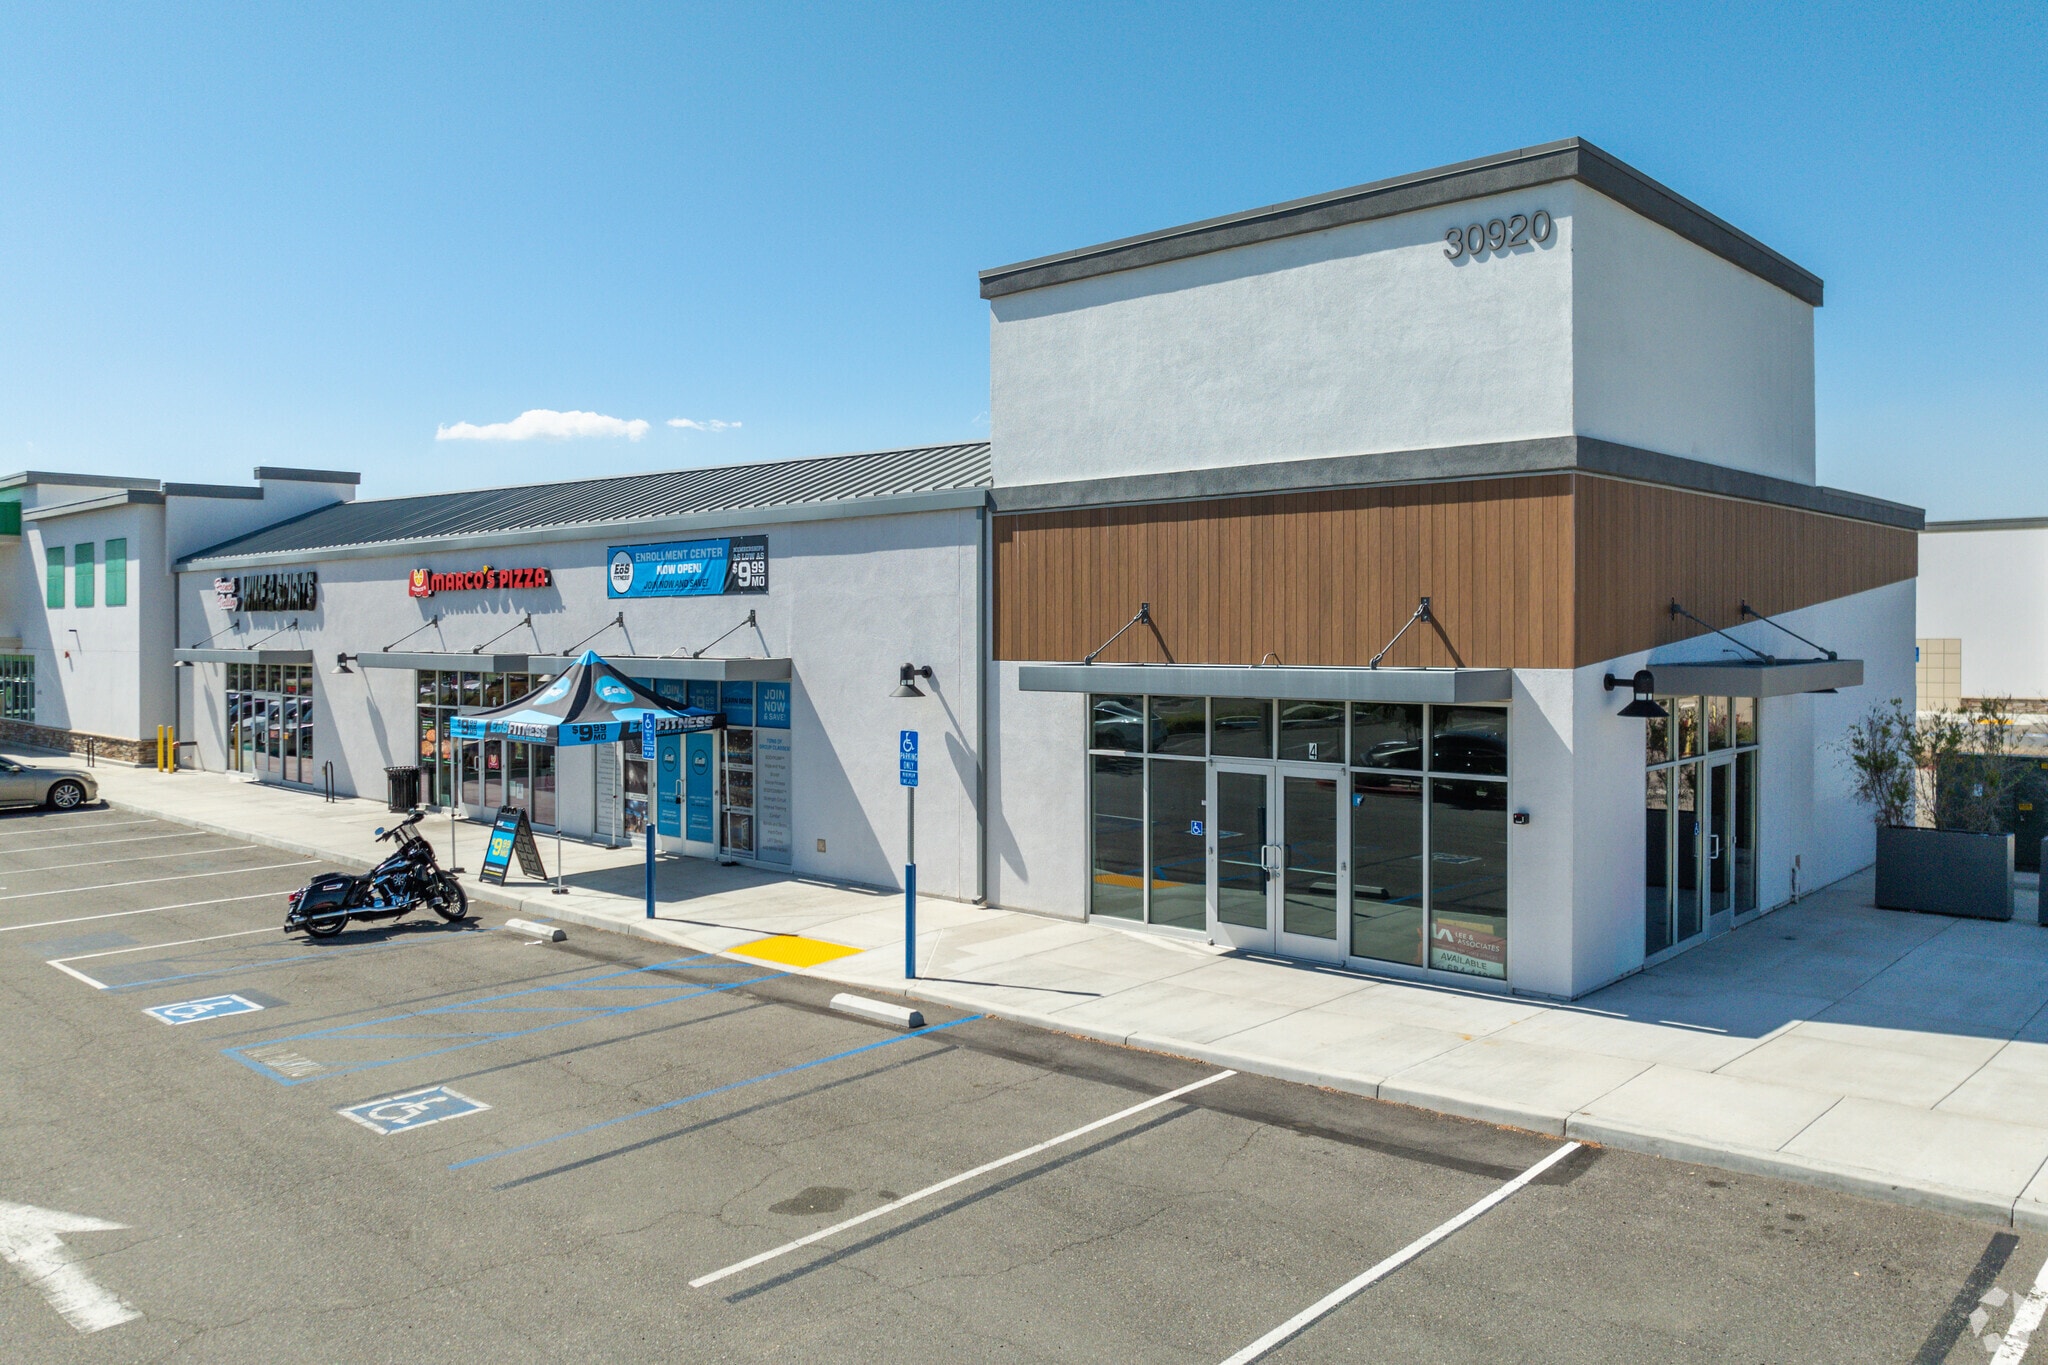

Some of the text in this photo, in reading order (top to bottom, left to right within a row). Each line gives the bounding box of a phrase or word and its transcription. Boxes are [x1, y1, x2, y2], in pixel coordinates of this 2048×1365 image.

[1443, 209, 1551, 259] 30920
[635, 547, 723, 563] ENROLLMENT CENTER
[656, 563, 702, 575] NOW OPEN!
[430, 565, 546, 591] MARCO'S PIZZA
[643, 578, 709, 590] JOIN NOW AND SAVE!
[764, 690, 785, 699] JOIN
[764, 701, 786, 713] NOW
[508, 721, 549, 738] FITNESS
[656, 715, 714, 730] FITNESS
[1310, 743, 1317, 759] 4
[1455, 931, 1467, 940] LEE
[1457, 939, 1500, 952] ASSOCIATES
[1441, 952, 1487, 970] AVAILABLE
